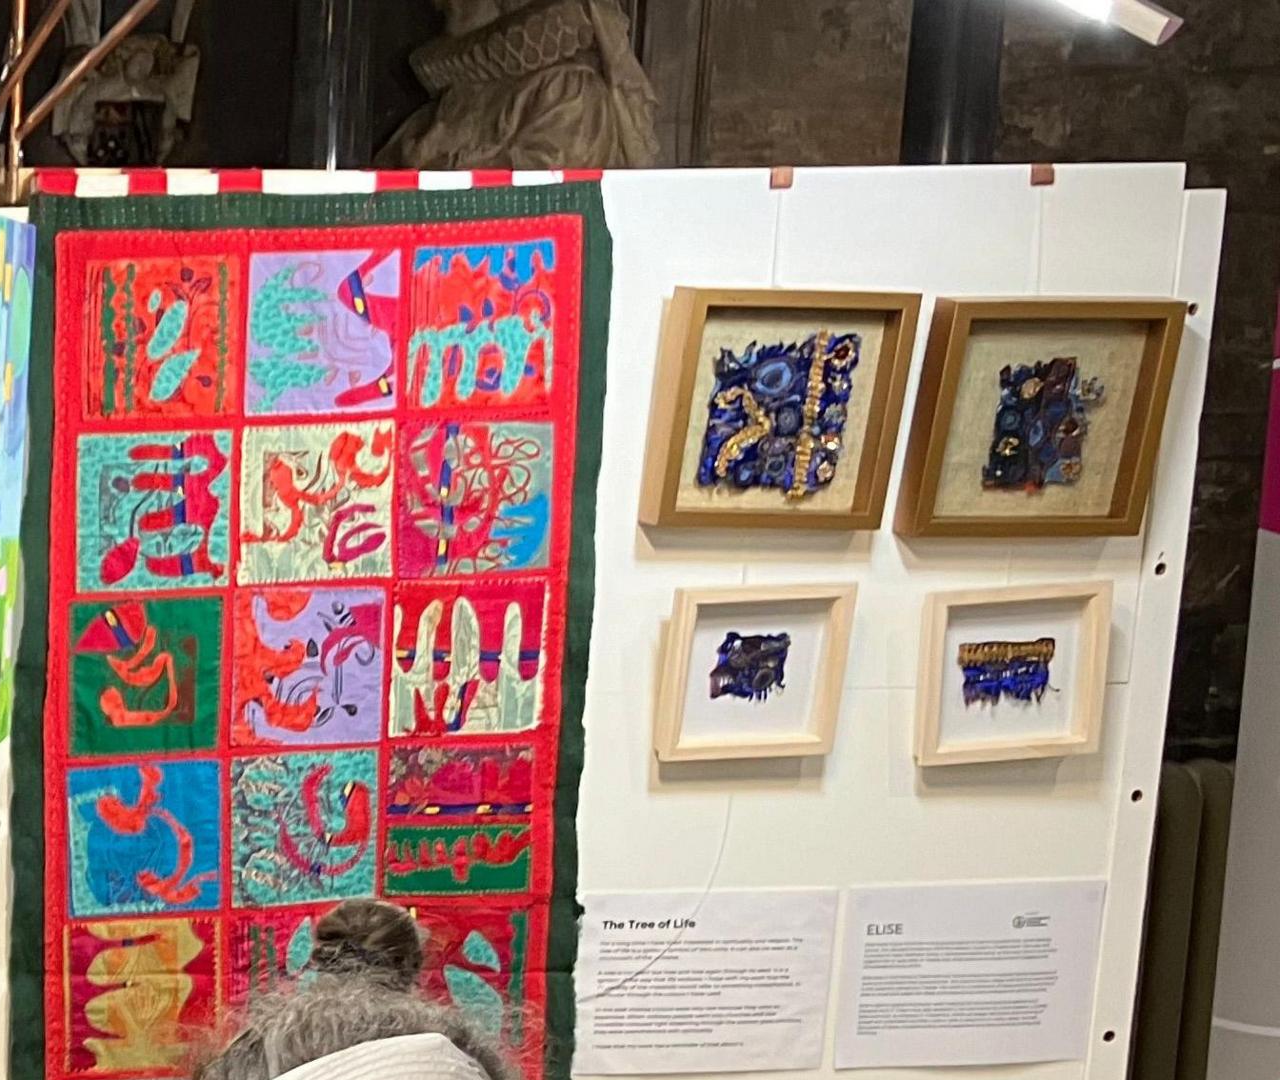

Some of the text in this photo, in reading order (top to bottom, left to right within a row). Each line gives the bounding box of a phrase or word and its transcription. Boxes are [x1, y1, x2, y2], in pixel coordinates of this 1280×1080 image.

[602, 918, 696, 930] The Tree of Life
[866, 922, 904, 936] ELISE
